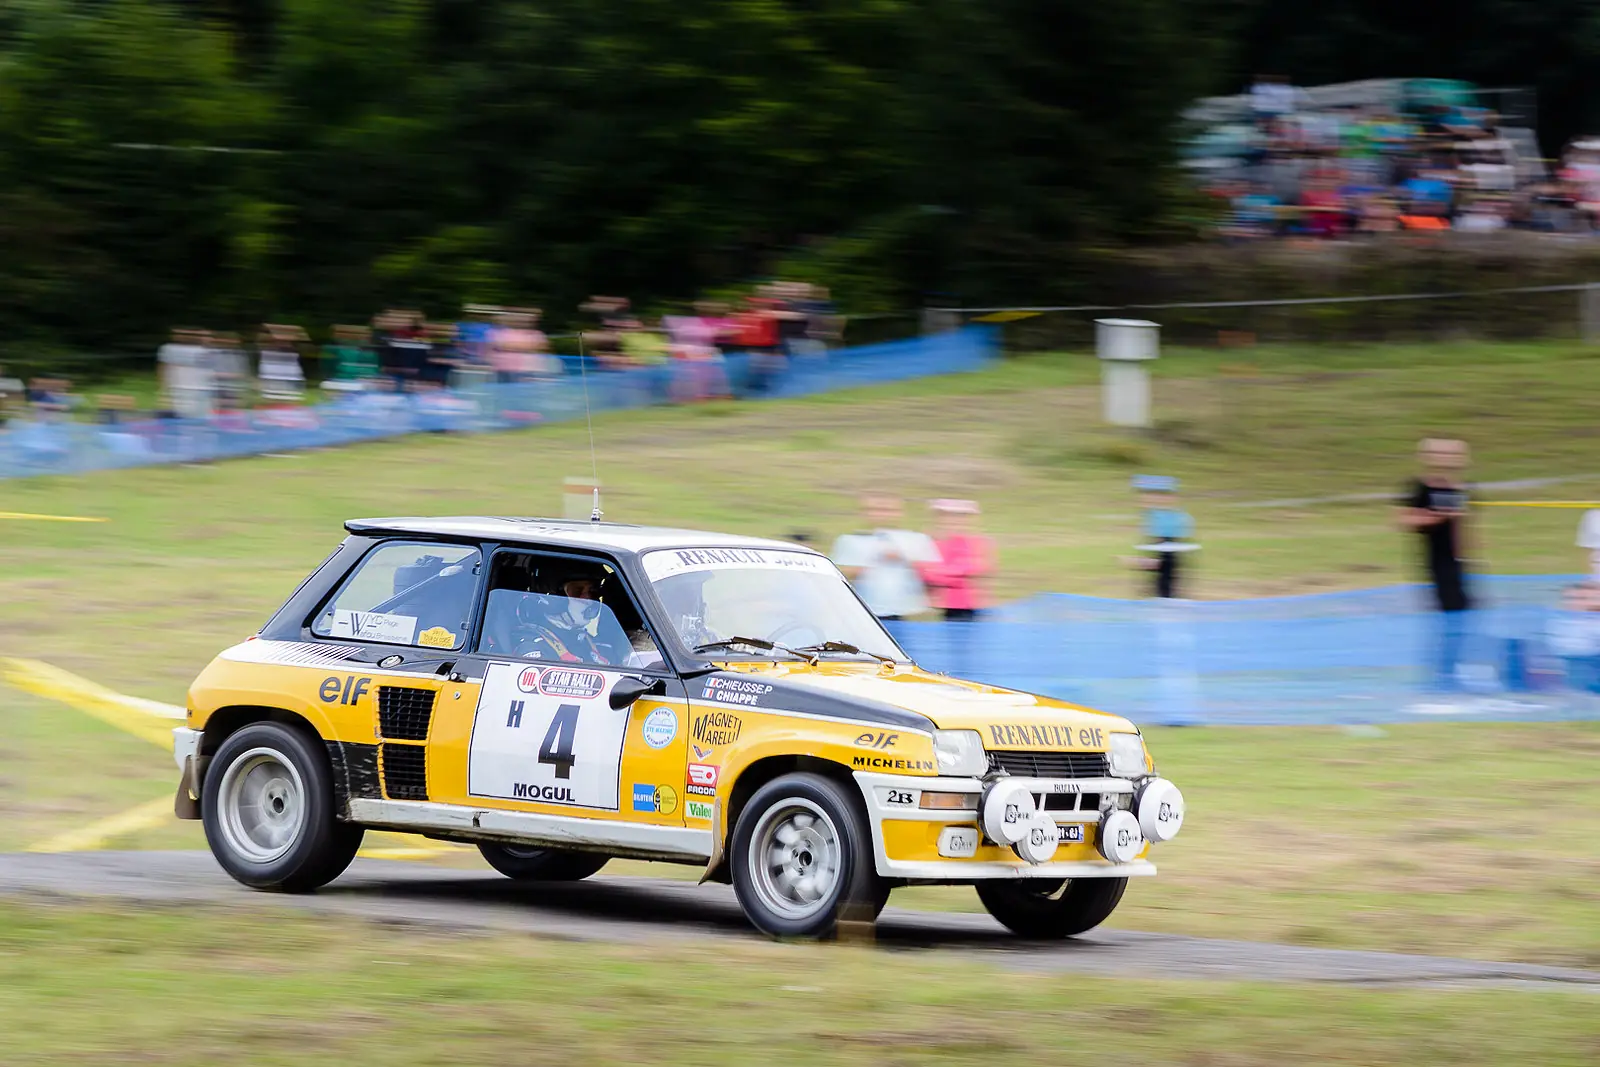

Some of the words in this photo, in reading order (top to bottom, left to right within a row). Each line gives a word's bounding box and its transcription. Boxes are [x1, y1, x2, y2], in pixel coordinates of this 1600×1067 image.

[674, 549, 766, 566] RENAULT
[548, 671, 571, 686] STAR
[571, 673, 597, 688] RALLY
[319, 676, 372, 706] elf
[716, 690, 758, 705] CHIAPPE
[506, 700, 525, 728] H
[538, 704, 581, 779] 4
[853, 732, 899, 749] elf
[989, 724, 1074, 746] RENAULT
[1079, 728, 1103, 747] elf
[853, 756, 933, 770] MICHELIN
[513, 783, 576, 802] MOGUL
[687, 785, 716, 797] FACOM
[689, 802, 712, 818] Valeo
